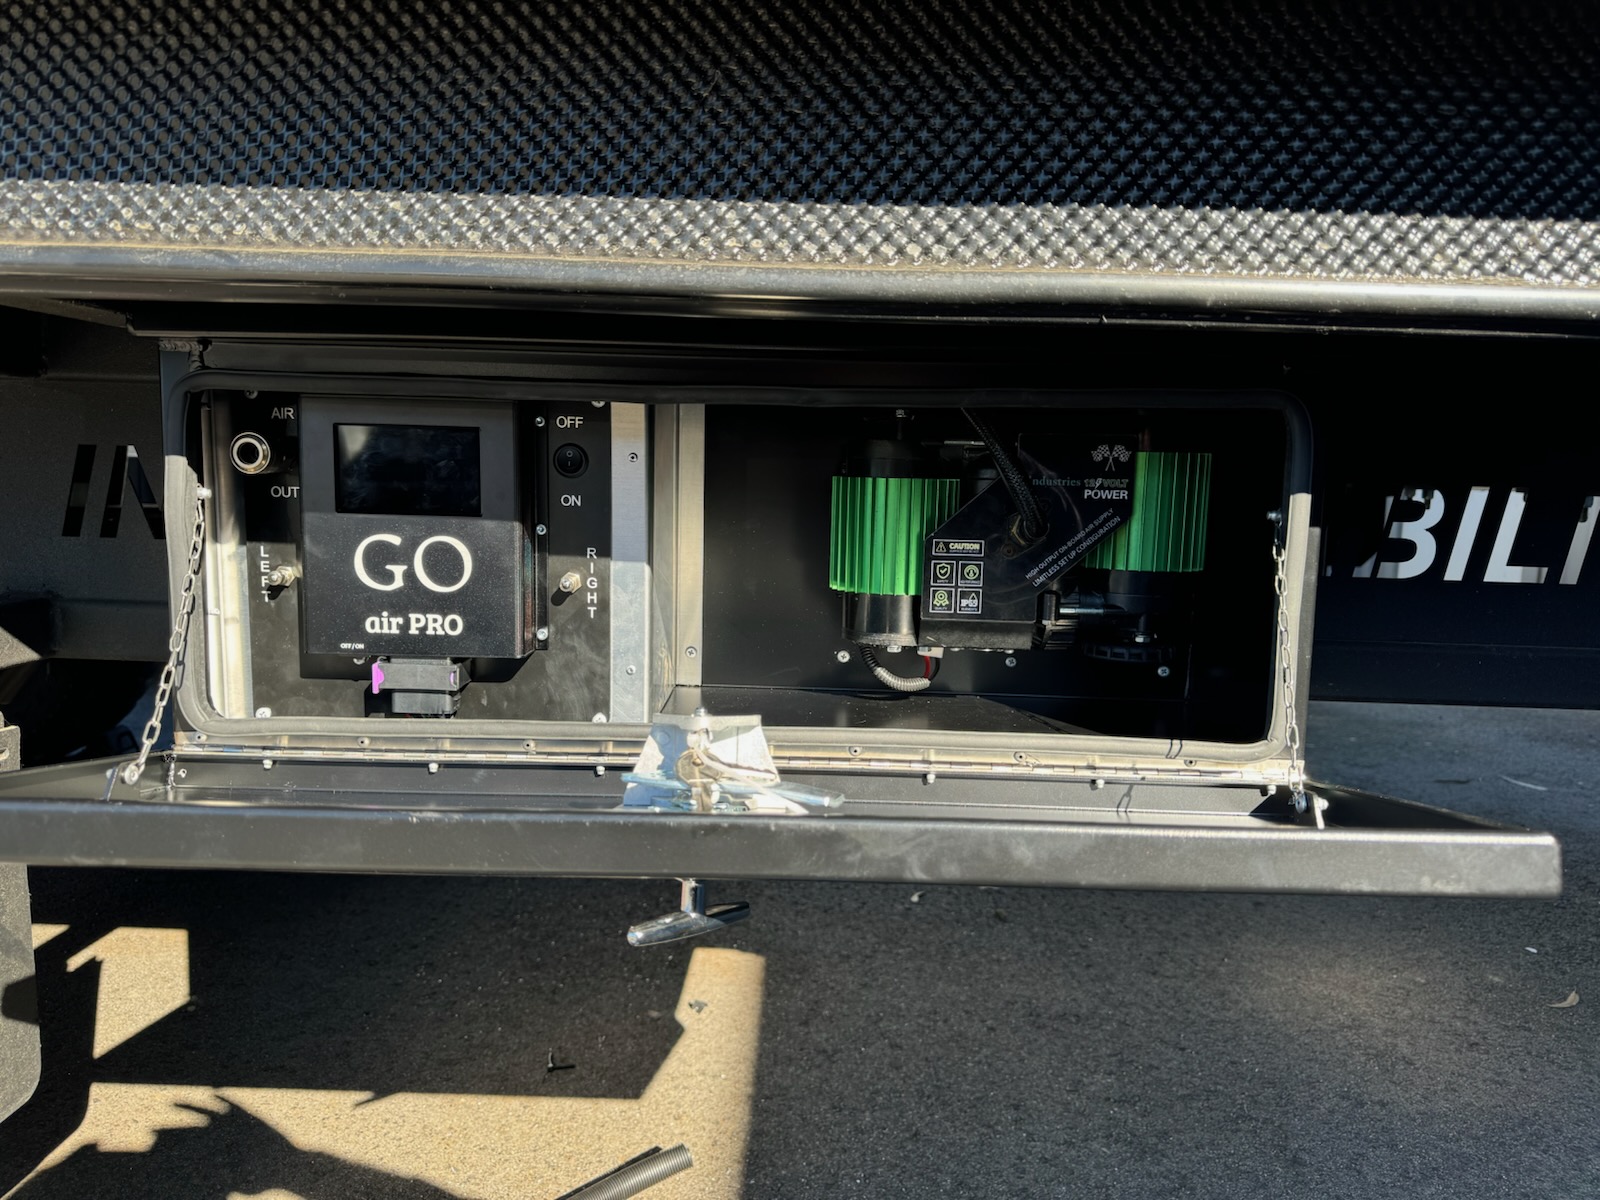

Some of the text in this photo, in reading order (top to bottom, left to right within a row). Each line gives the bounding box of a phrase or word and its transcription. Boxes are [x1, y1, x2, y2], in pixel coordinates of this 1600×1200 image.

[271, 407, 295, 420] AIR
[556, 415, 584, 429] OFF
[1029, 475, 1081, 487] ndustries
[270, 486, 300, 498] OUT
[1084, 489, 1129, 500] POWER
[560, 495, 582, 507] ON
[949, 542, 981, 550] CAUTION
[1025, 507, 1114, 580] HIGH OUTPUT ON-BOARD AIR SUPPLY
[353, 533, 473, 593] GO
[1032, 563, 1061, 588] LIMITLESS
[1058, 556, 1070, 568] SET
[1068, 550, 1077, 560] UP
[259, 545, 272, 603] LEFT
[586, 547, 598, 619] RIGHT
[365, 611, 463, 636] air PRO
